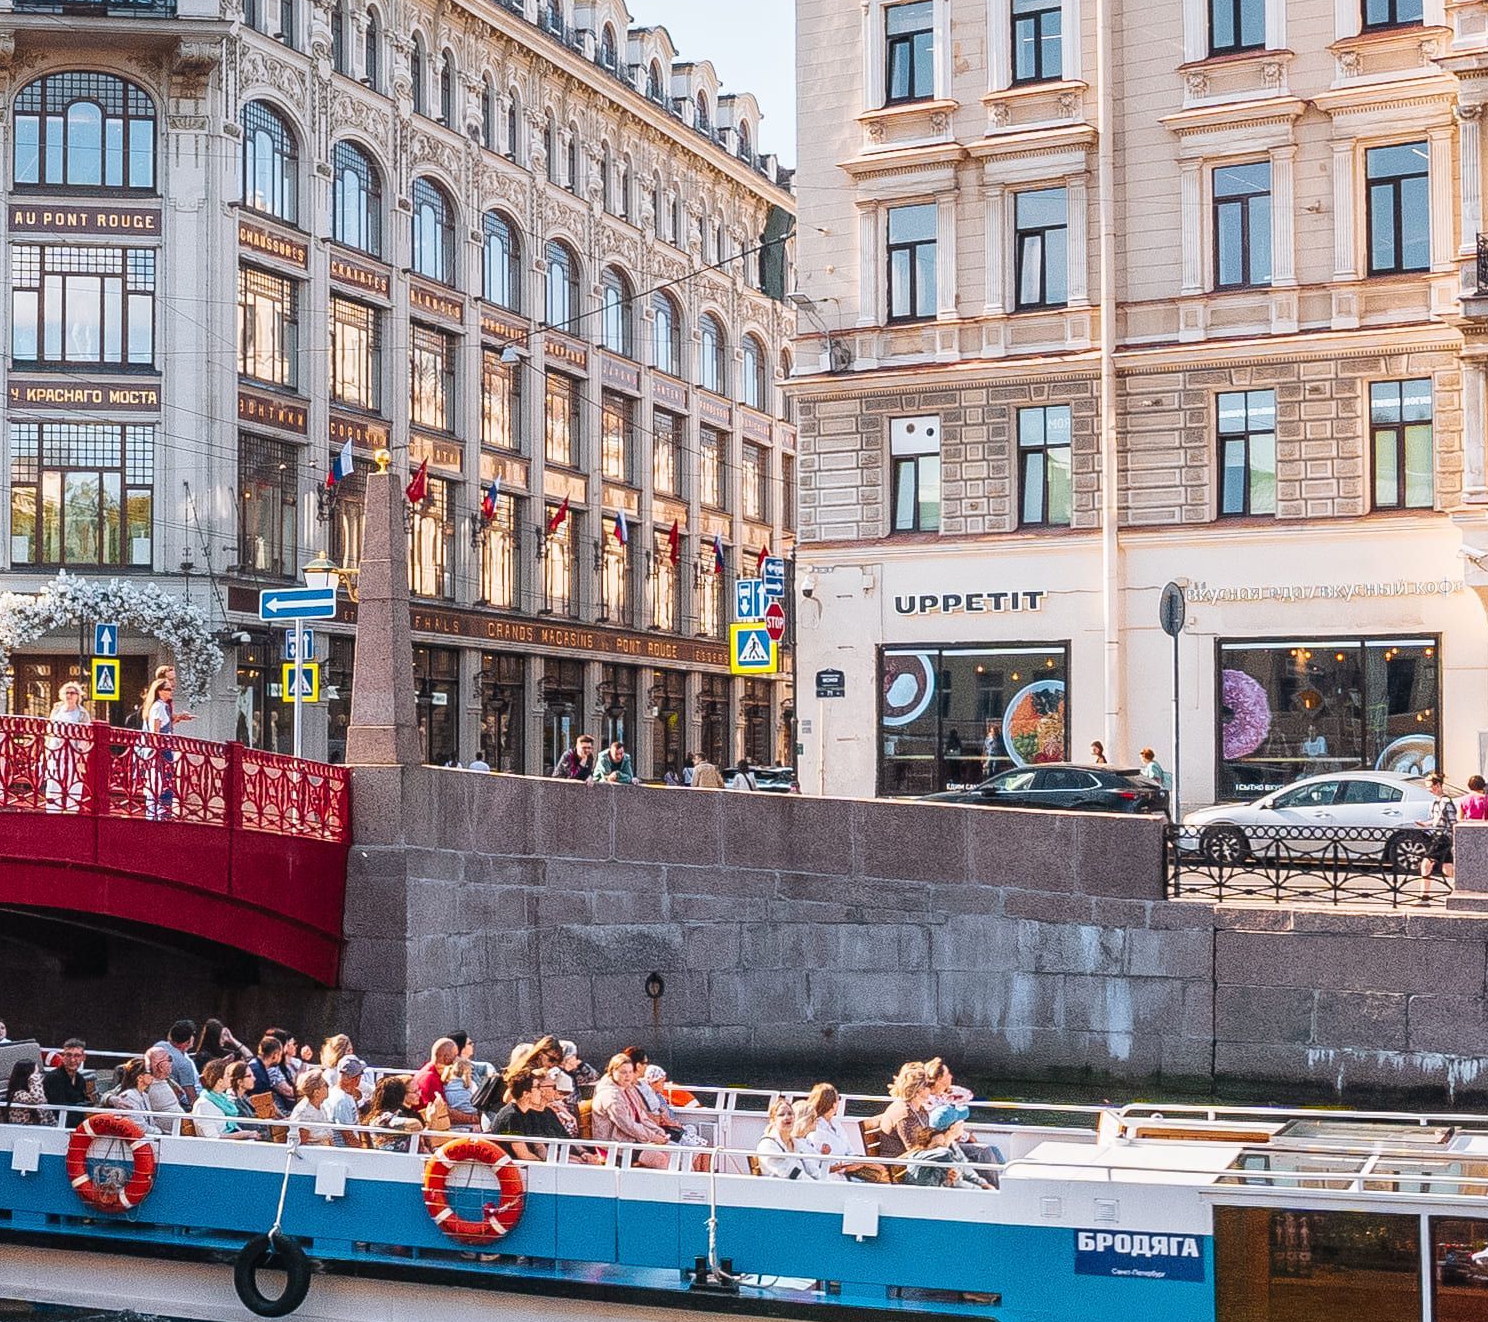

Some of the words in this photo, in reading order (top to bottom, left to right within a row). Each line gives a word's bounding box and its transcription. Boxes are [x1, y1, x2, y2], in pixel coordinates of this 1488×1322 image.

[14, 211, 36, 225] AU
[43, 212, 88, 227] PONT
[97, 214, 155, 229] ROUGE
[240, 228, 305, 262] CHAUSSURES
[10, 389, 19, 401] У
[27, 388, 102, 403] КРАСНАГО
[109, 389, 157, 404] МОСТА
[239, 398, 304, 427] ЗОНТИКИ
[894, 590, 1047, 616] UPPETIT
[1186, 585, 1262, 606] вкусная
[1320, 579, 1409, 604] вкусный
[415, 615, 459, 633] FHALS
[488, 622, 533, 642] GRANDS
[541, 629, 593, 649] MAGASINS
[767, 617, 783, 629] STOP
[1078, 1232, 1199, 1257] БРОДЯГА
